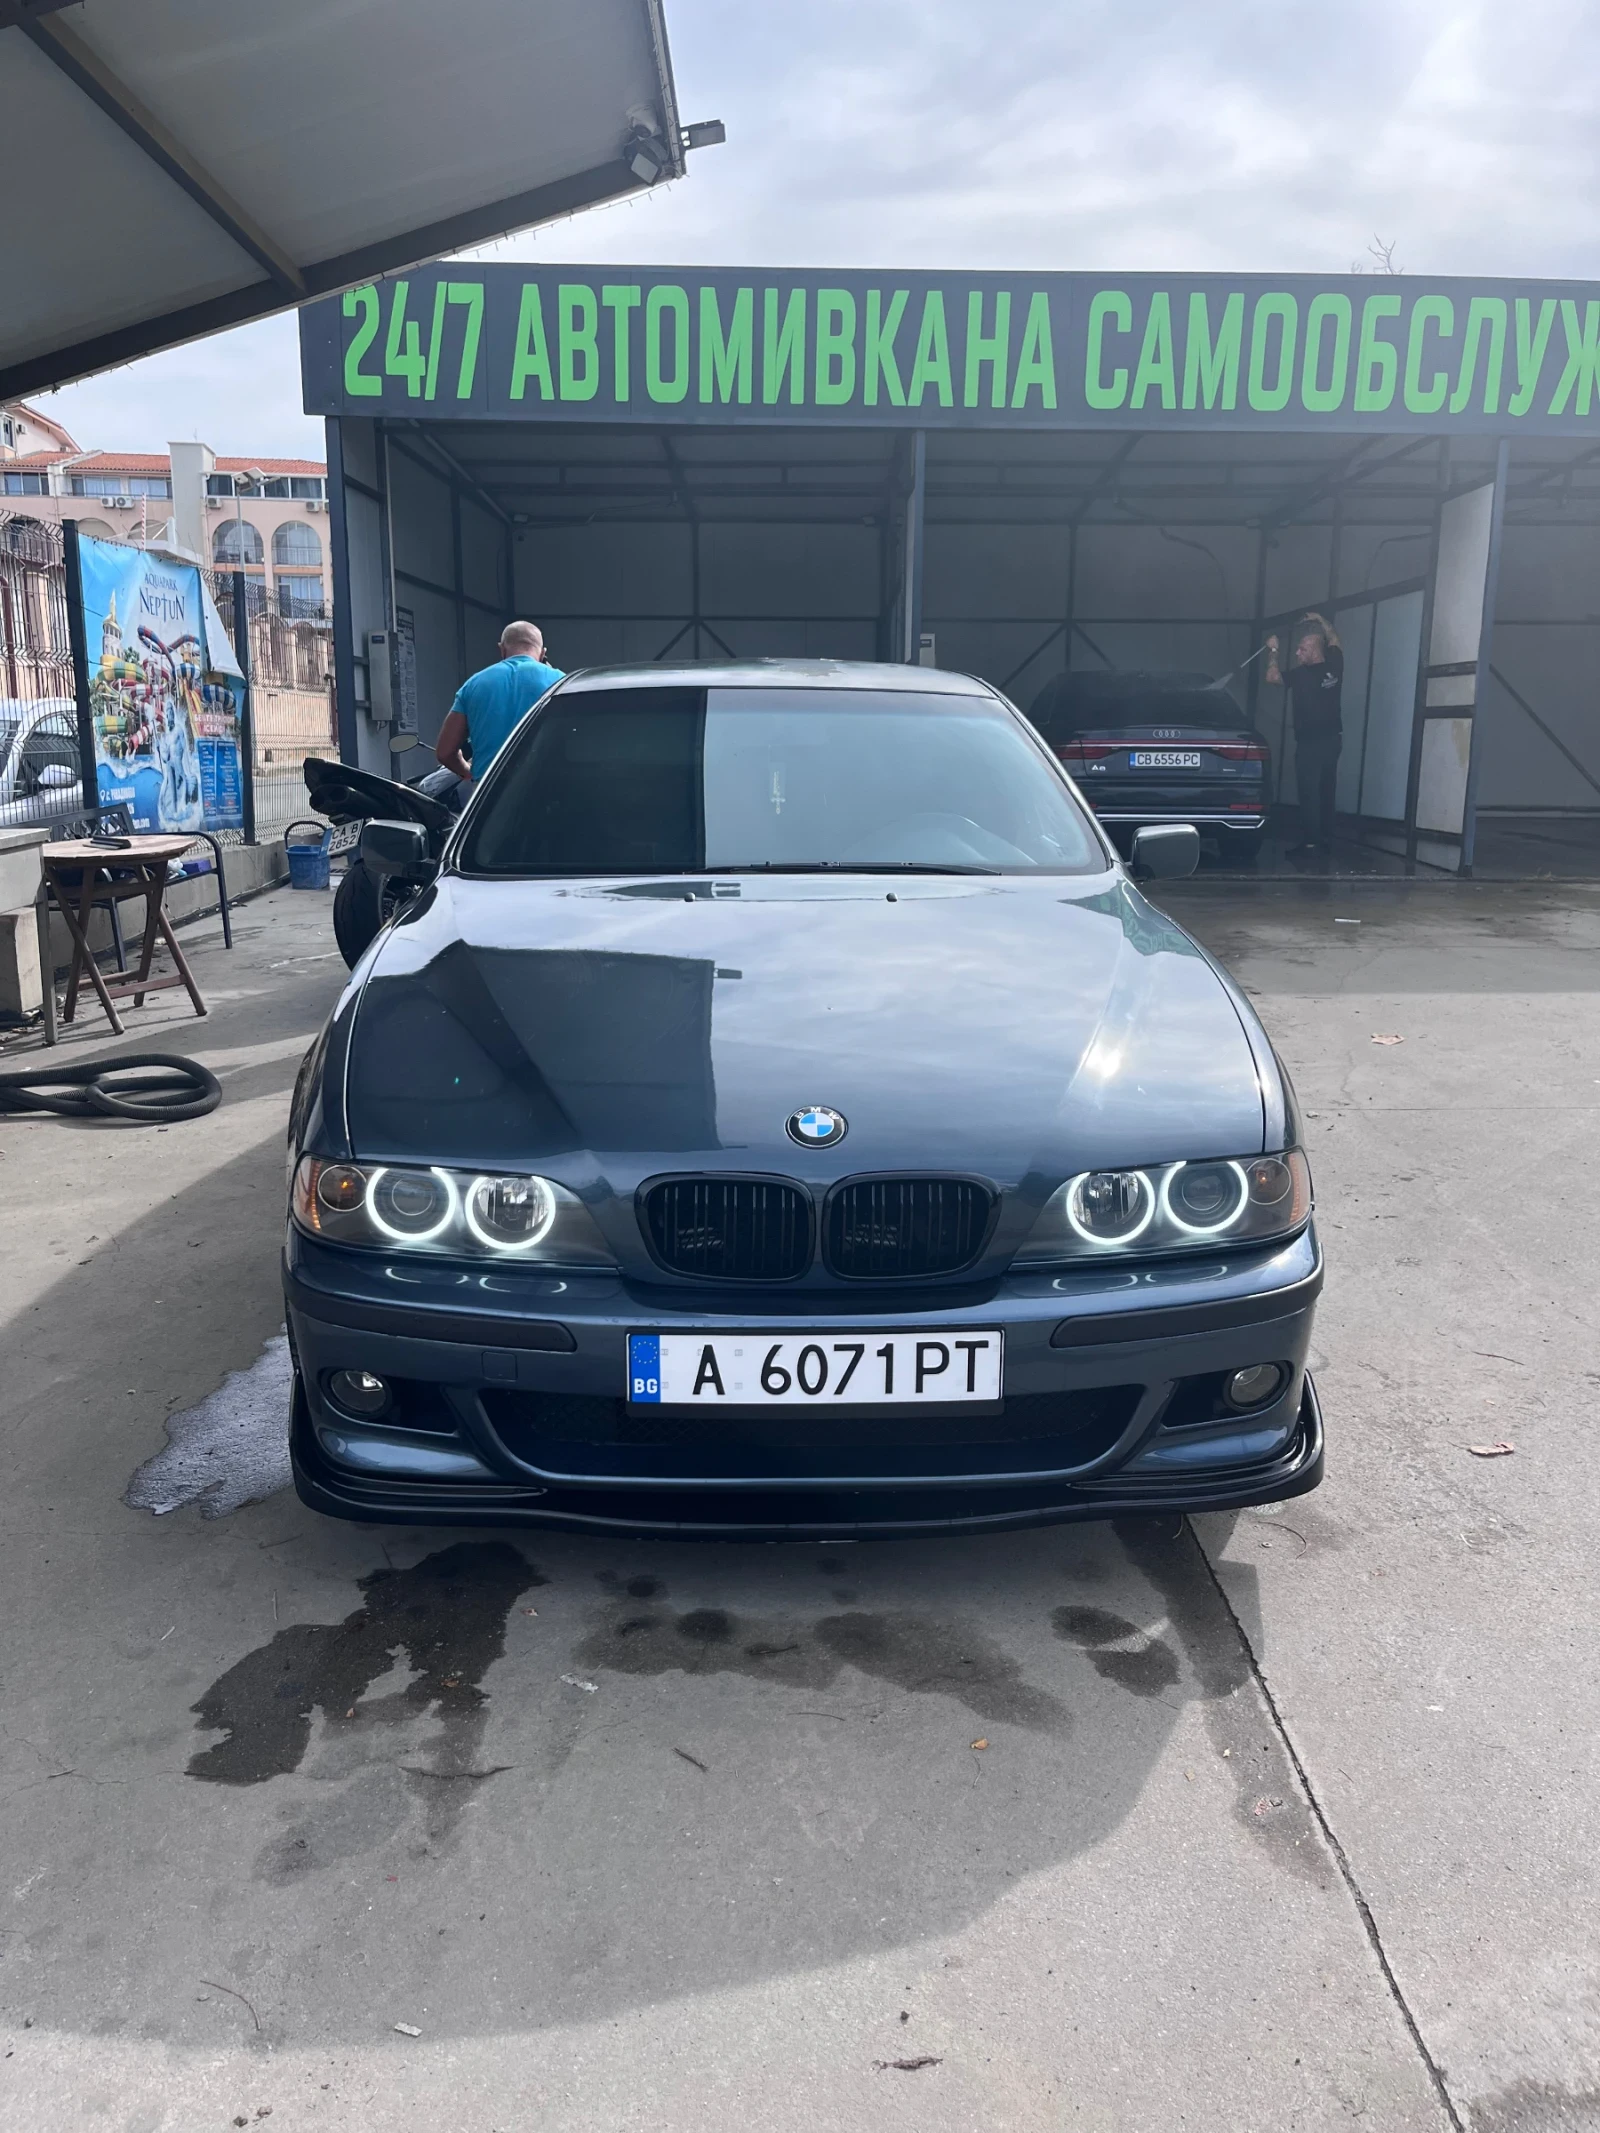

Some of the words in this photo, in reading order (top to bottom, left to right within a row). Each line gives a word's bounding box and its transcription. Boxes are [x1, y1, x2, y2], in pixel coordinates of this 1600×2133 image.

[342, 281, 485, 400] 24/7
[145, 573, 178, 591] AQUAPARK
[1154, 754, 1182, 765] 6556
[795, 1106, 840, 1120] BMW
[634, 1378, 658, 1394] BG
[692, 1344, 726, 1396] A
